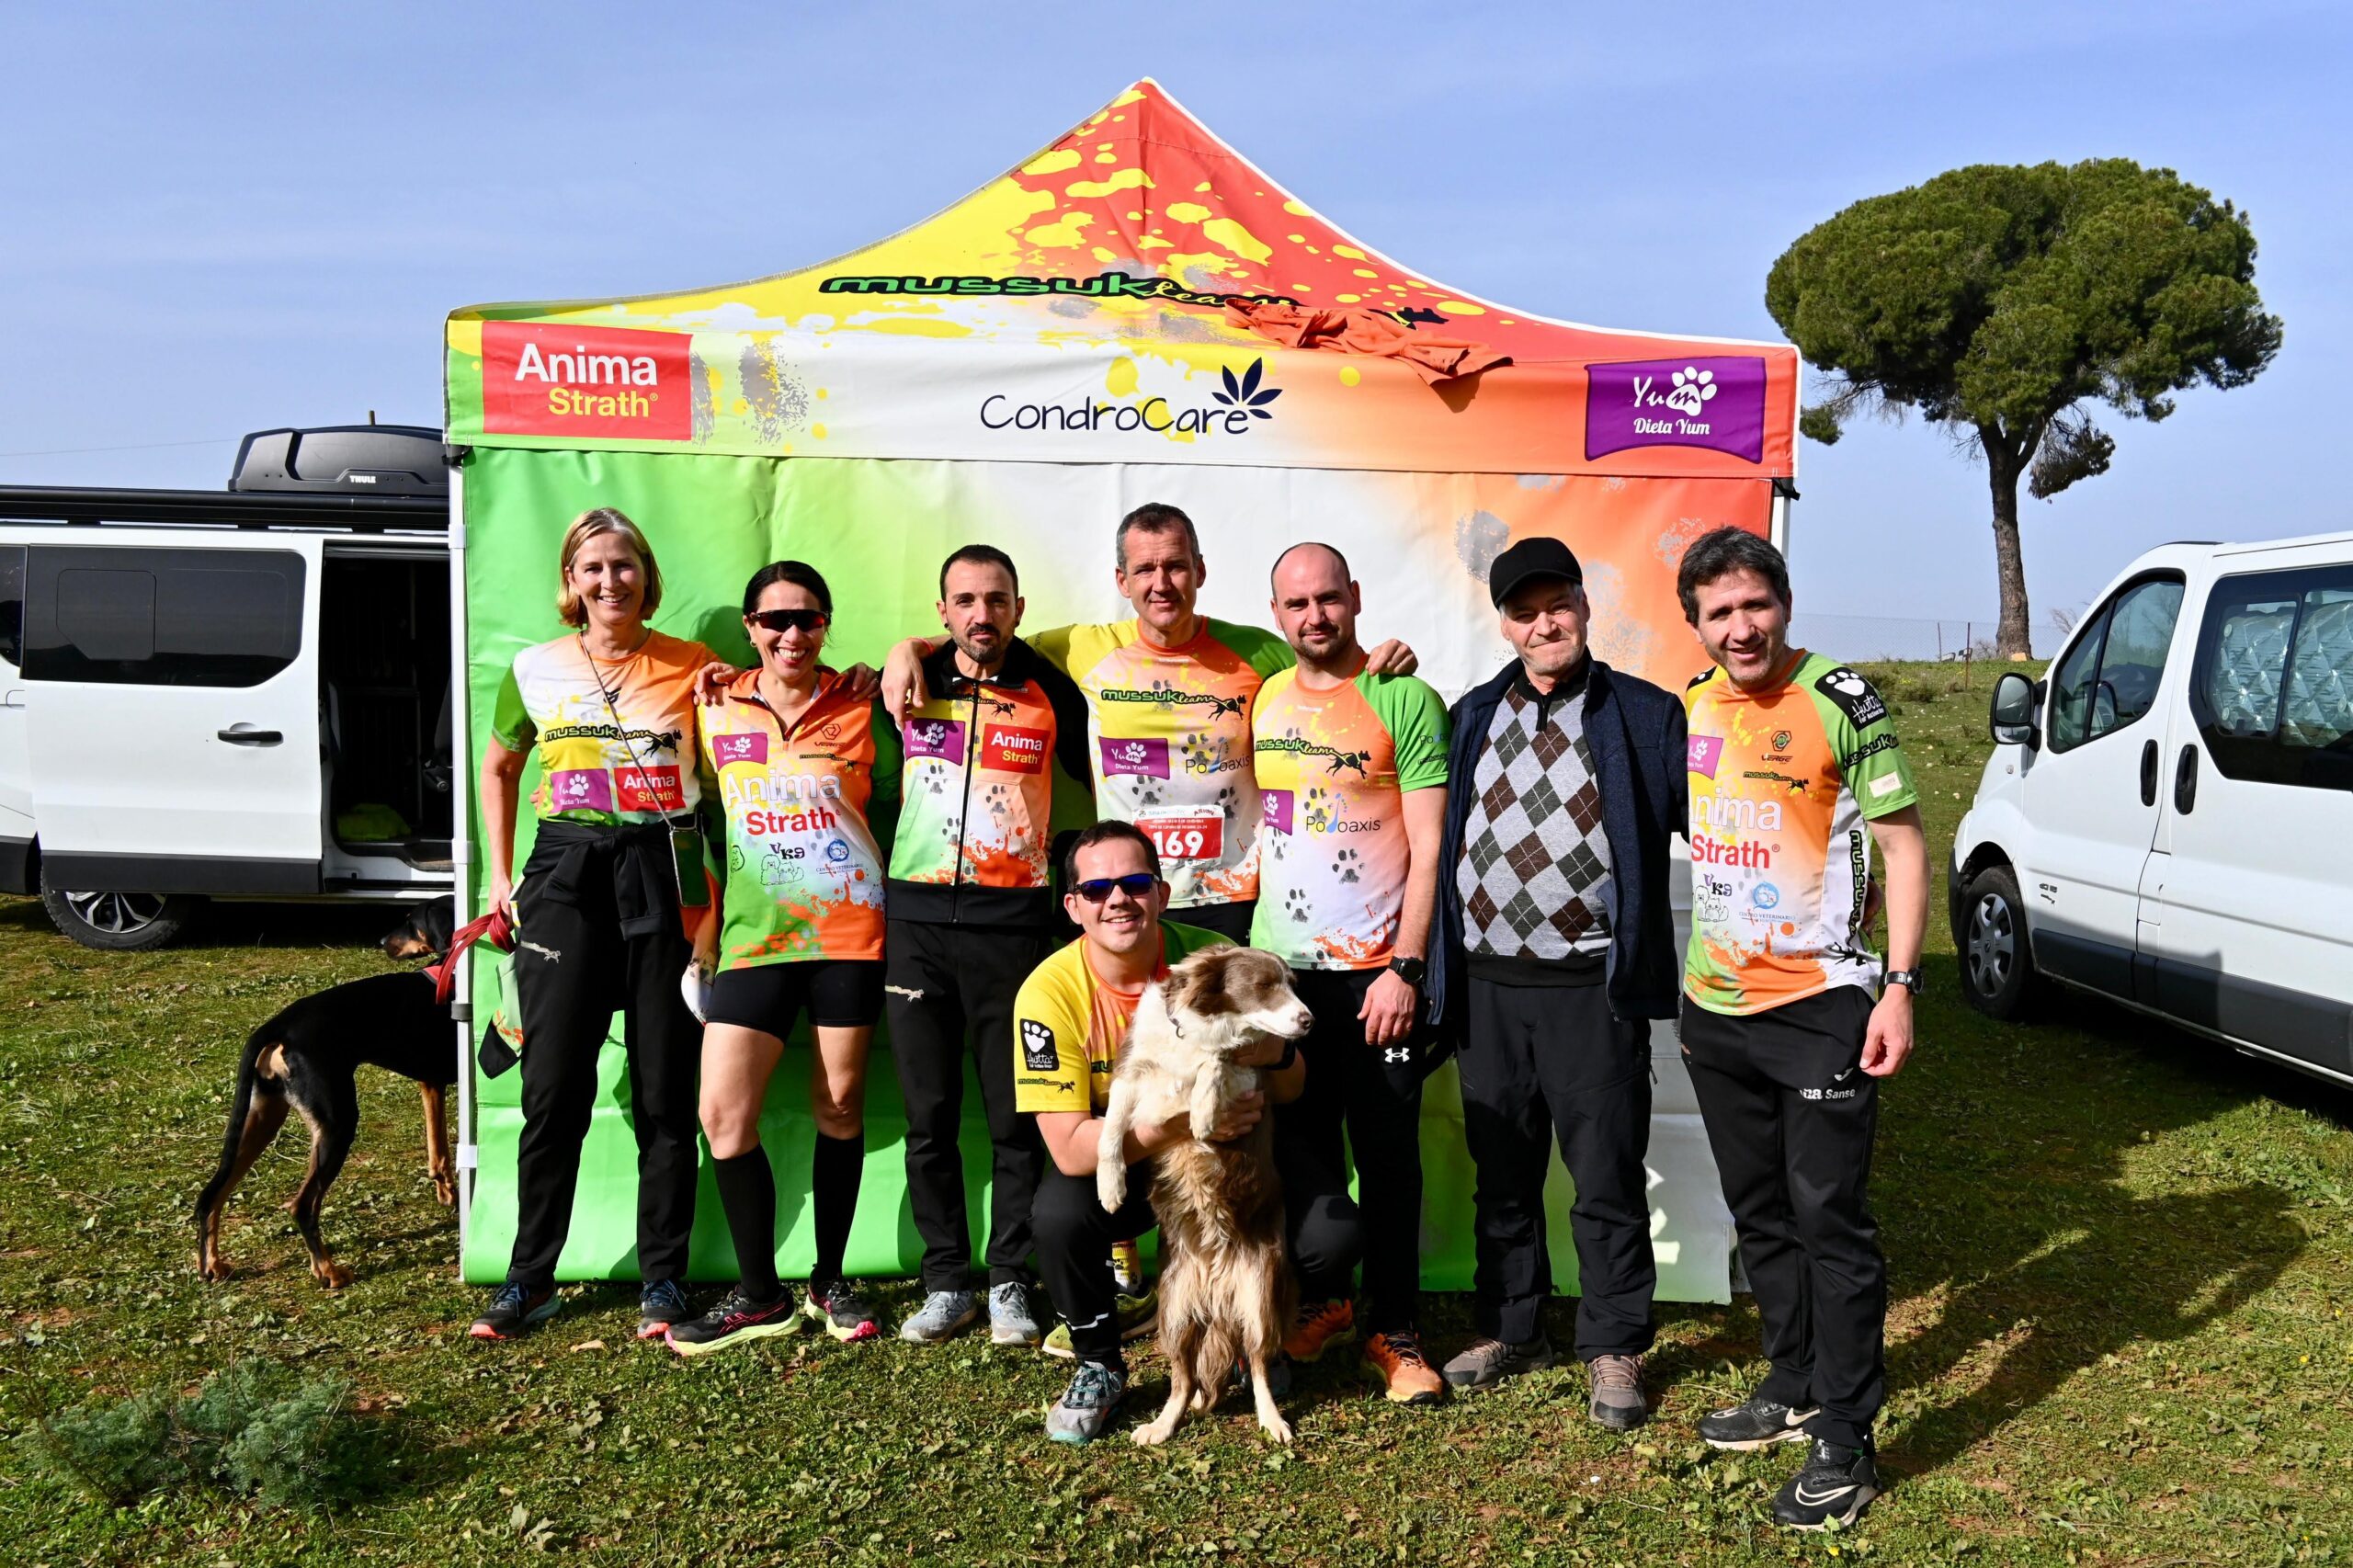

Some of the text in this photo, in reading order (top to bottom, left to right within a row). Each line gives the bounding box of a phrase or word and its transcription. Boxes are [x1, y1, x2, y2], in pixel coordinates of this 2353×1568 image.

[515, 343, 657, 385] Anima
[1633, 372, 1702, 412] Yum
[980, 394, 1249, 435] CondroCare
[1633, 417, 1710, 435] Dieta Yum
[349, 475, 376, 483] THULE
[991, 732, 1043, 751] Anima
[725, 767, 840, 808] Anima
[1689, 787, 1781, 831] nima
[1153, 830, 1204, 857] 169
[1825, 1089, 1855, 1099] Sanse
